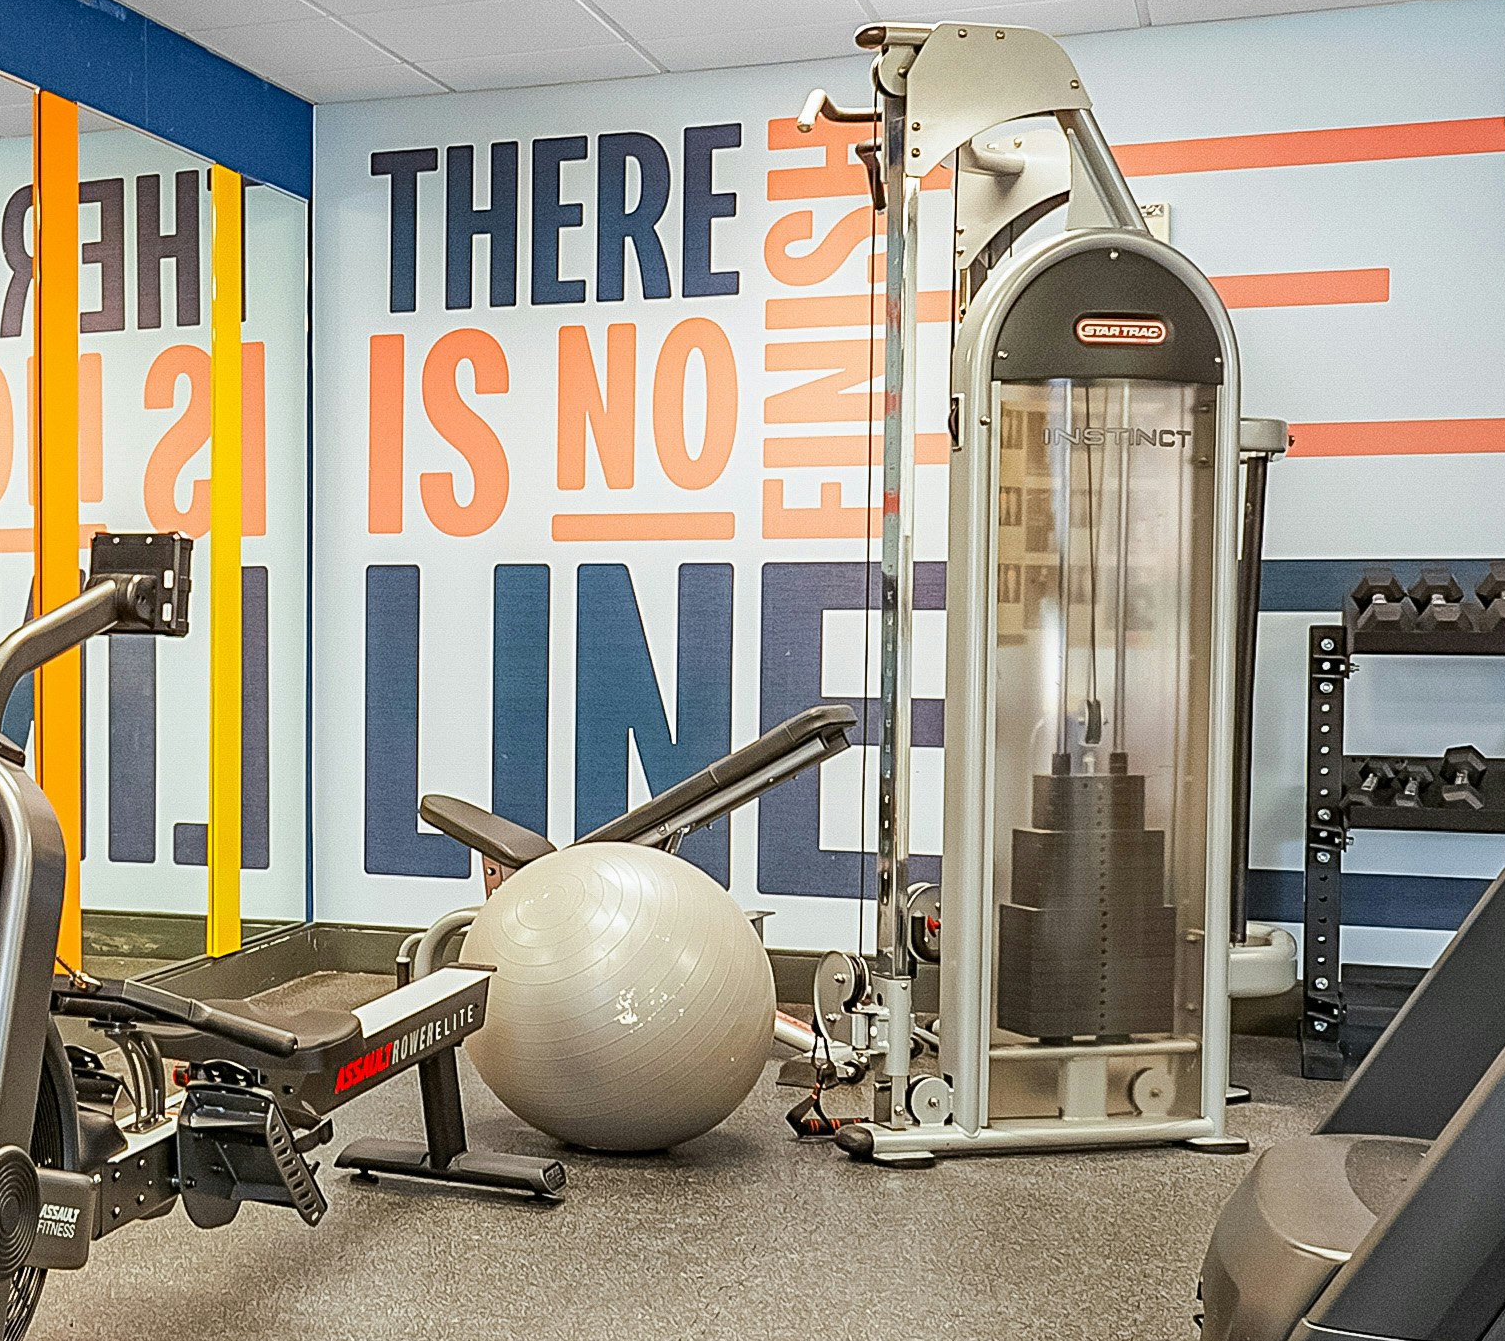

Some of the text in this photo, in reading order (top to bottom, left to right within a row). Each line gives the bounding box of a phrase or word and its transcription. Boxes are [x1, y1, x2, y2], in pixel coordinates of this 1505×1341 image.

[370, 122, 742, 313] THERE
[762, 116, 888, 539] FINISH
[1083, 325, 1159, 338] STAR TRAC
[368, 317, 739, 538] IS NO
[1043, 426, 1191, 448] INSTINCT
[364, 561, 948, 896] LINE
[36, 1219, 76, 1238] FITNESS
[38, 1203, 80, 1223] ASSAULT
